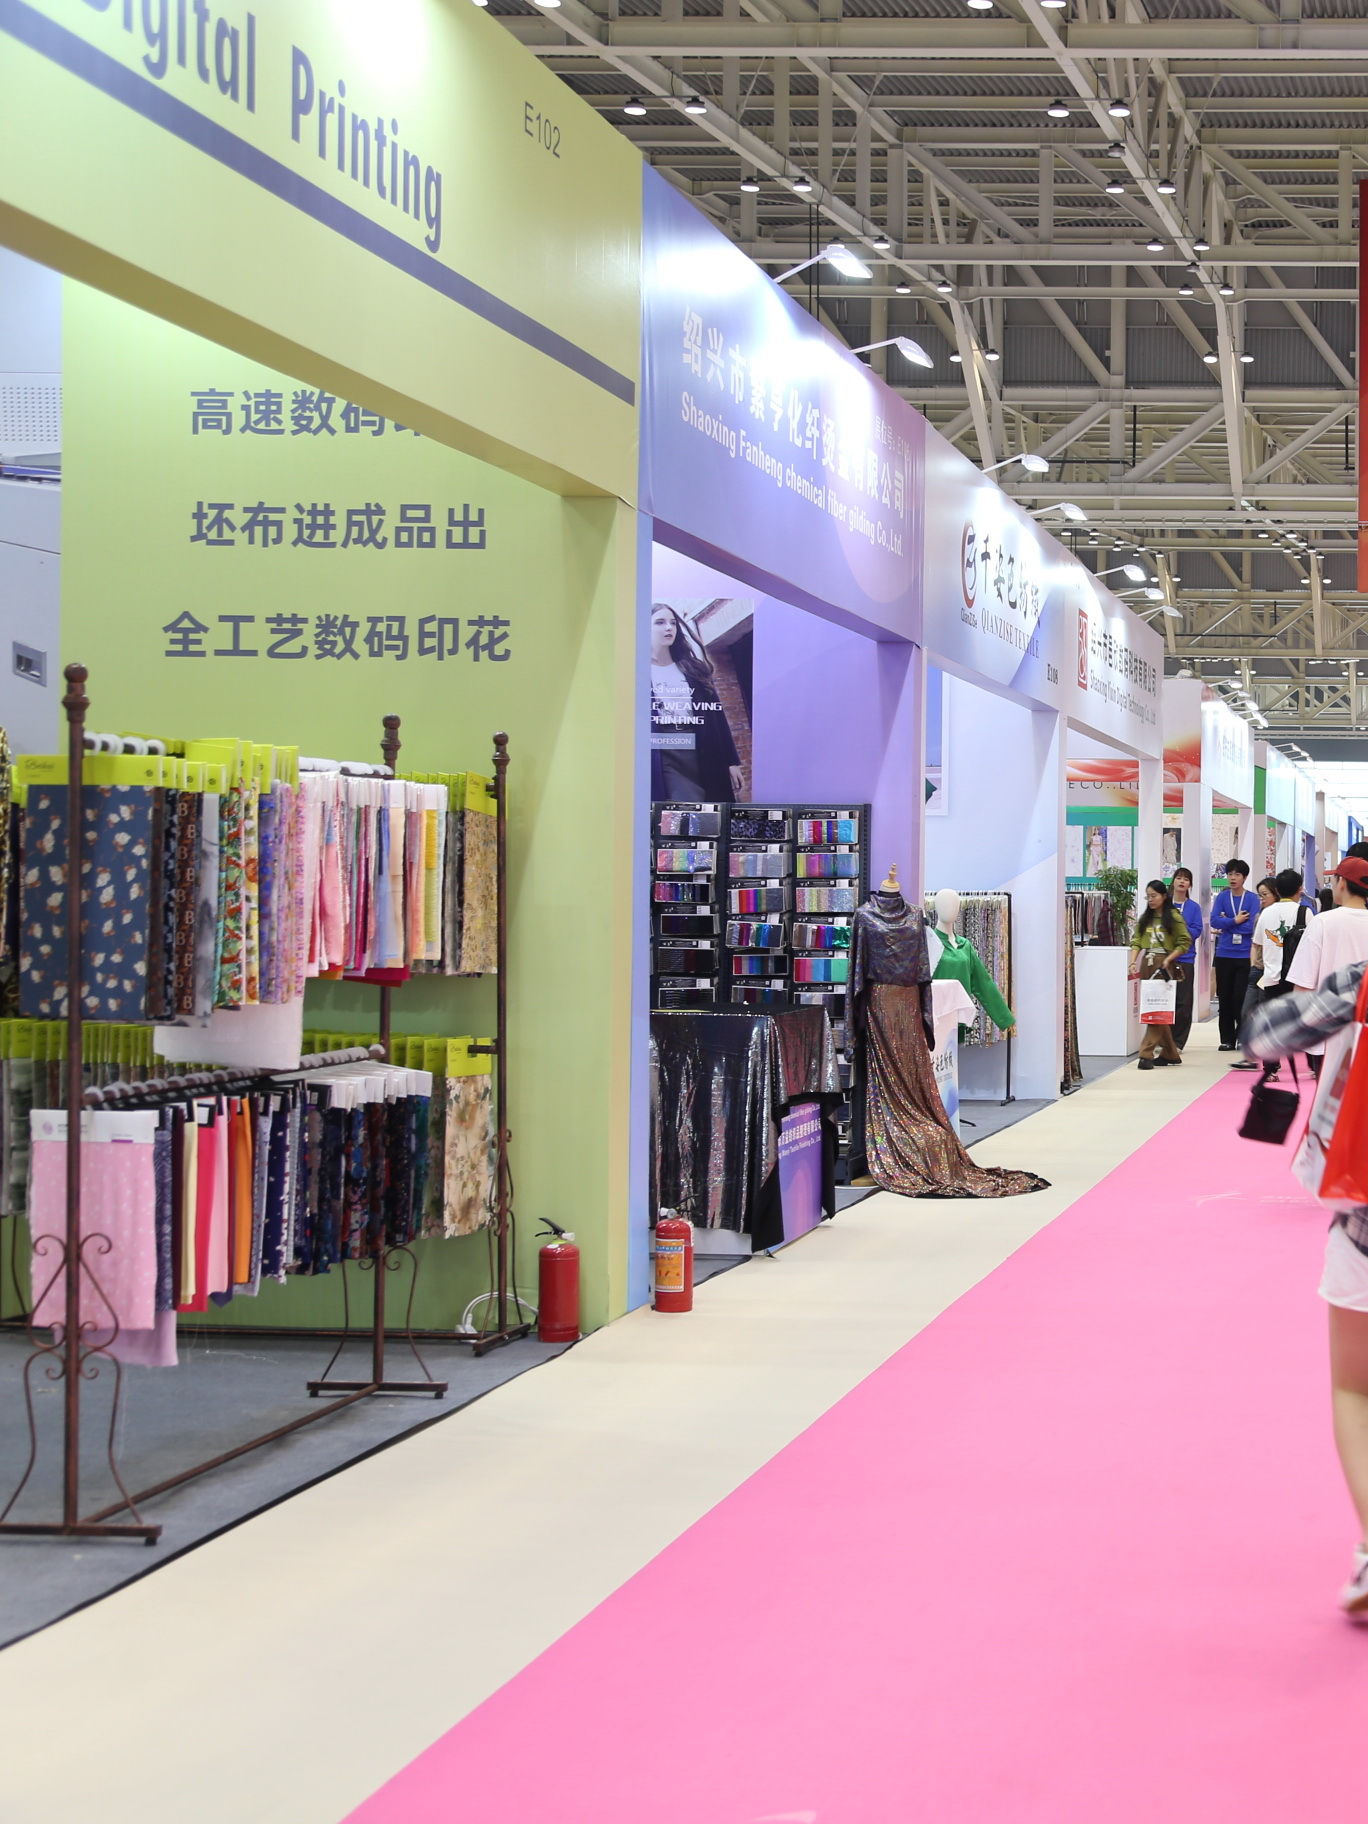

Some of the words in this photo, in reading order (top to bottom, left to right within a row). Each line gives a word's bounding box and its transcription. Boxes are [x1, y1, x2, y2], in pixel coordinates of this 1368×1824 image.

[82, 0, 256, 115] gital
[292, 44, 443, 254] Printing
[523, 99, 562, 160] E102
[190, 388, 422, 437] 高速数码
[682, 391, 736, 458] Shaoxing
[740, 428, 783, 488] Fanheng
[786, 463, 826, 511] chemical
[827, 488, 847, 523] fiber
[849, 504, 875, 545] gilding
[190, 501, 487, 550] 坯布进成品出
[162, 611, 511, 662] 全工艺数码印花
[664, 701, 723, 711] WEAVING
[651, 737, 692, 745] ROFESSION
